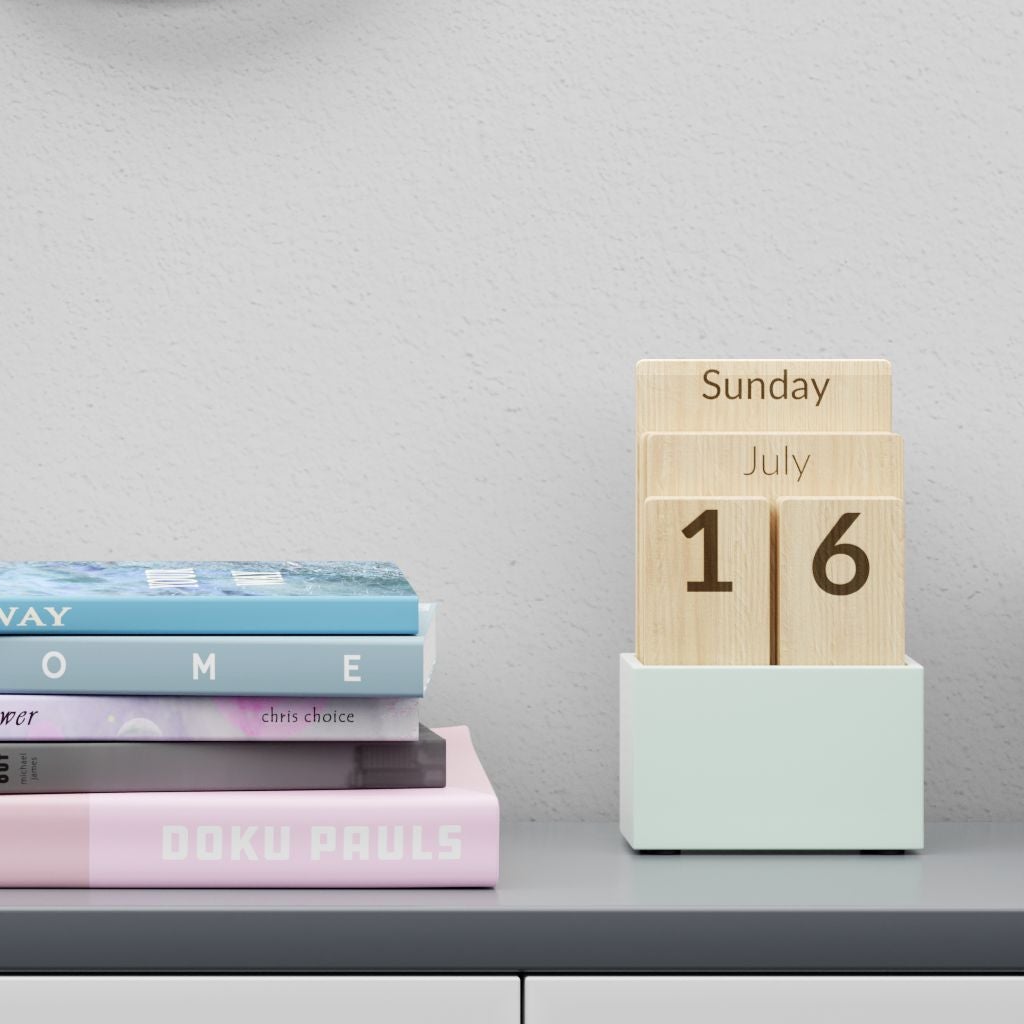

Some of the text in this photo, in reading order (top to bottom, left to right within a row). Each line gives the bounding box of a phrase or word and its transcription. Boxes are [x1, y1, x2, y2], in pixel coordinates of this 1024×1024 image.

[701, 369, 831, 407] Sunday
[743, 445, 812, 482] July
[261, 706, 355, 724] chris choice
[162, 824, 463, 861] DOKU PAULS
